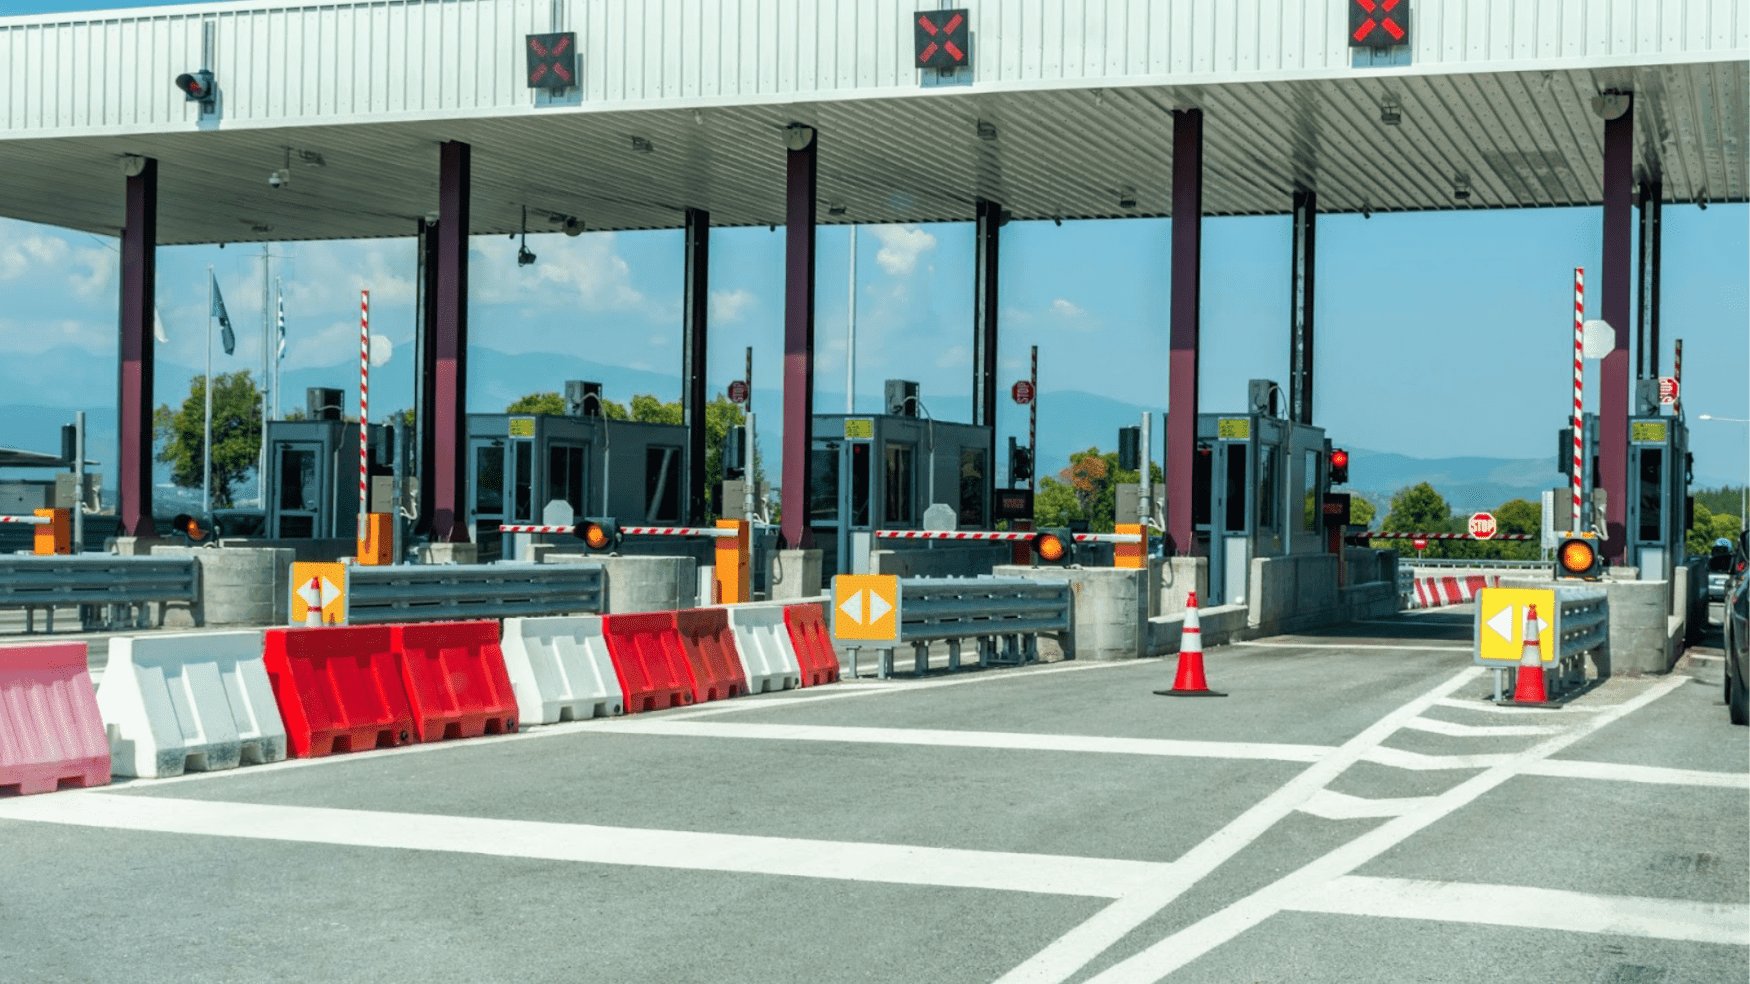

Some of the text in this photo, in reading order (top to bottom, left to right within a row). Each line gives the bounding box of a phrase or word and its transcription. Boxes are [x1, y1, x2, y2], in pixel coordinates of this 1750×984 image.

[732, 383, 744, 402] STOP
[1016, 382, 1029, 403] STOP
[1470, 519, 1496, 532] STOP
